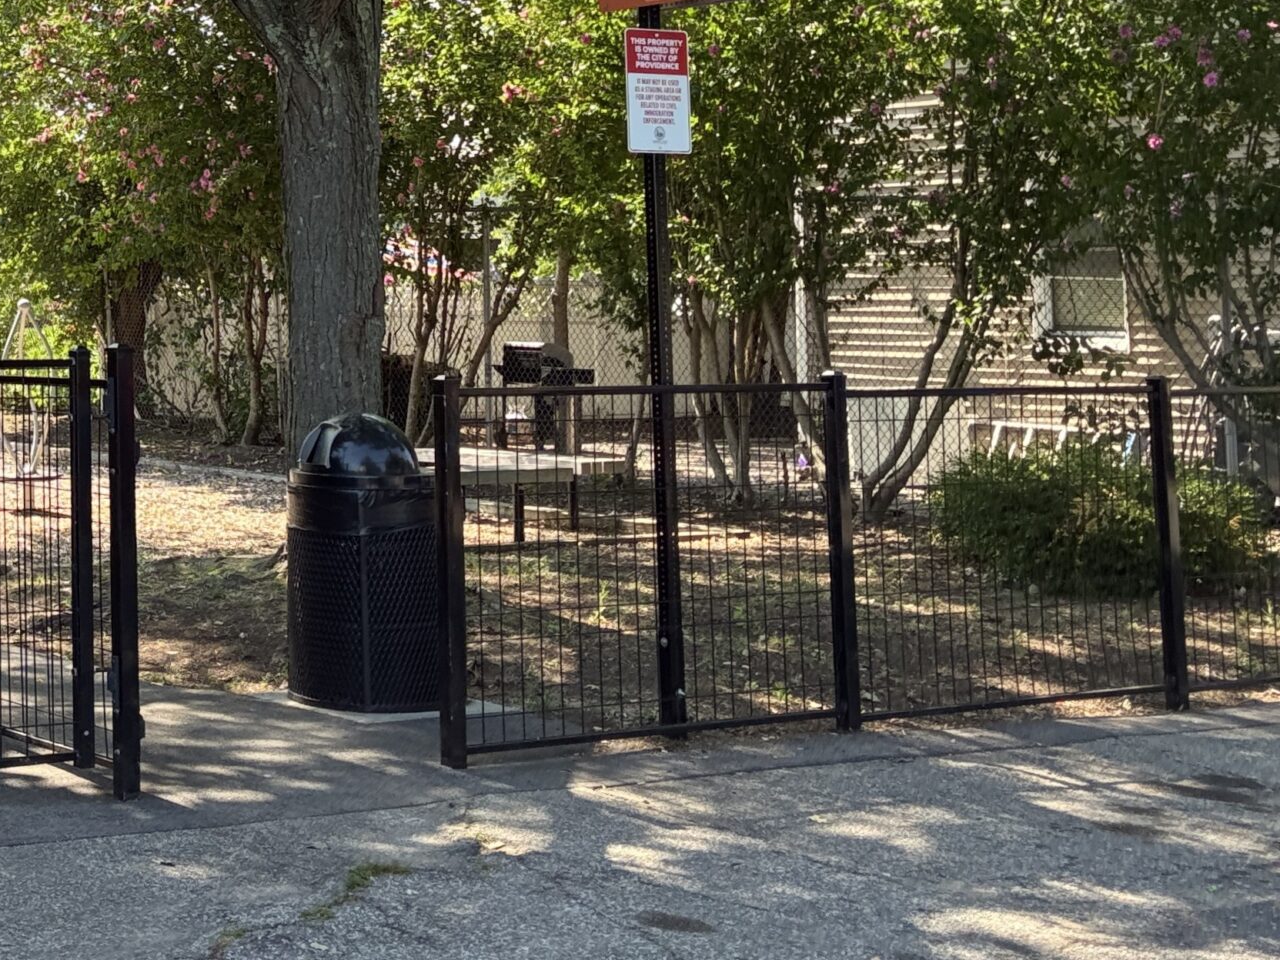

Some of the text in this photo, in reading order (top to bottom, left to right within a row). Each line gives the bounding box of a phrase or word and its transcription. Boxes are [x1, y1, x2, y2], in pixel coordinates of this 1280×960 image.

[631, 37, 683, 47] THIS PROPERTY
[643, 46, 668, 54] OWNED
[670, 47, 679, 55] BY
[637, 53, 650, 61] THE
[651, 54, 667, 62] CITY
[635, 61, 680, 70] PROVIDENCE
